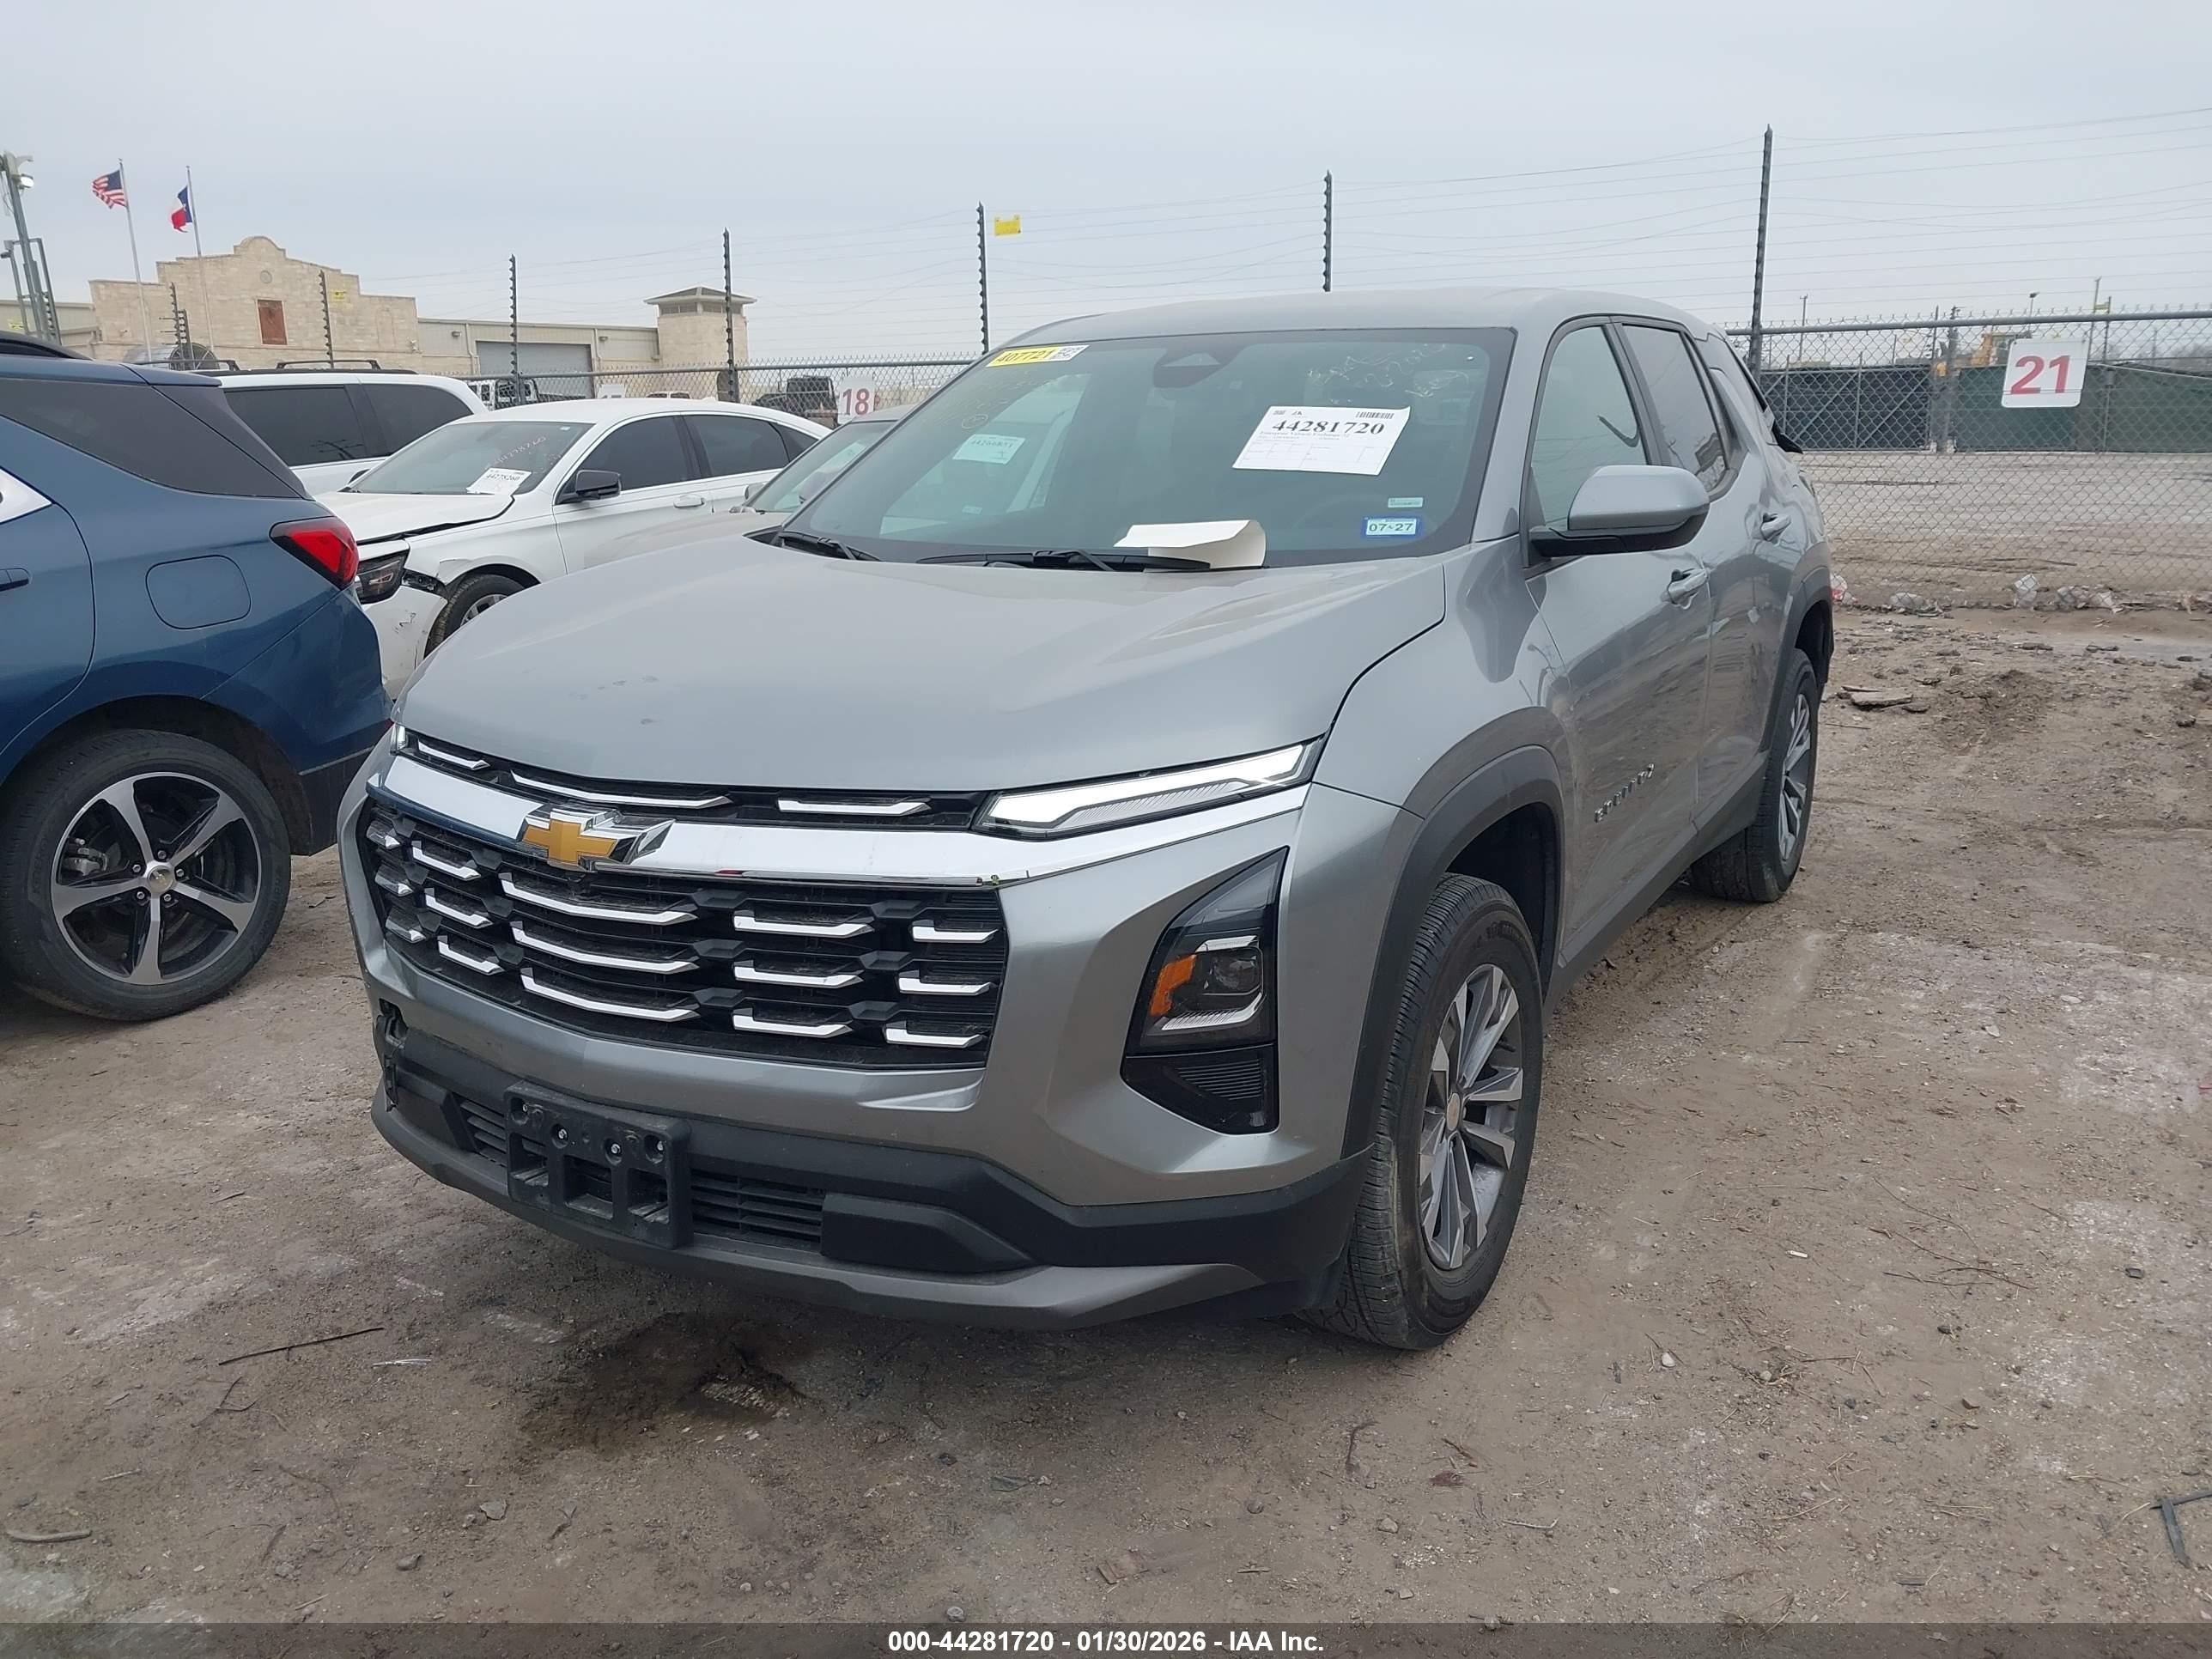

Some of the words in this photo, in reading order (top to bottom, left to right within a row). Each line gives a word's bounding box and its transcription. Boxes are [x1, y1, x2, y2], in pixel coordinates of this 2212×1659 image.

[997, 349, 1055, 362] 407721
[2010, 355, 2070, 394] 21
[842, 388, 870, 416] 18
[1273, 420, 1384, 434] 44281720
